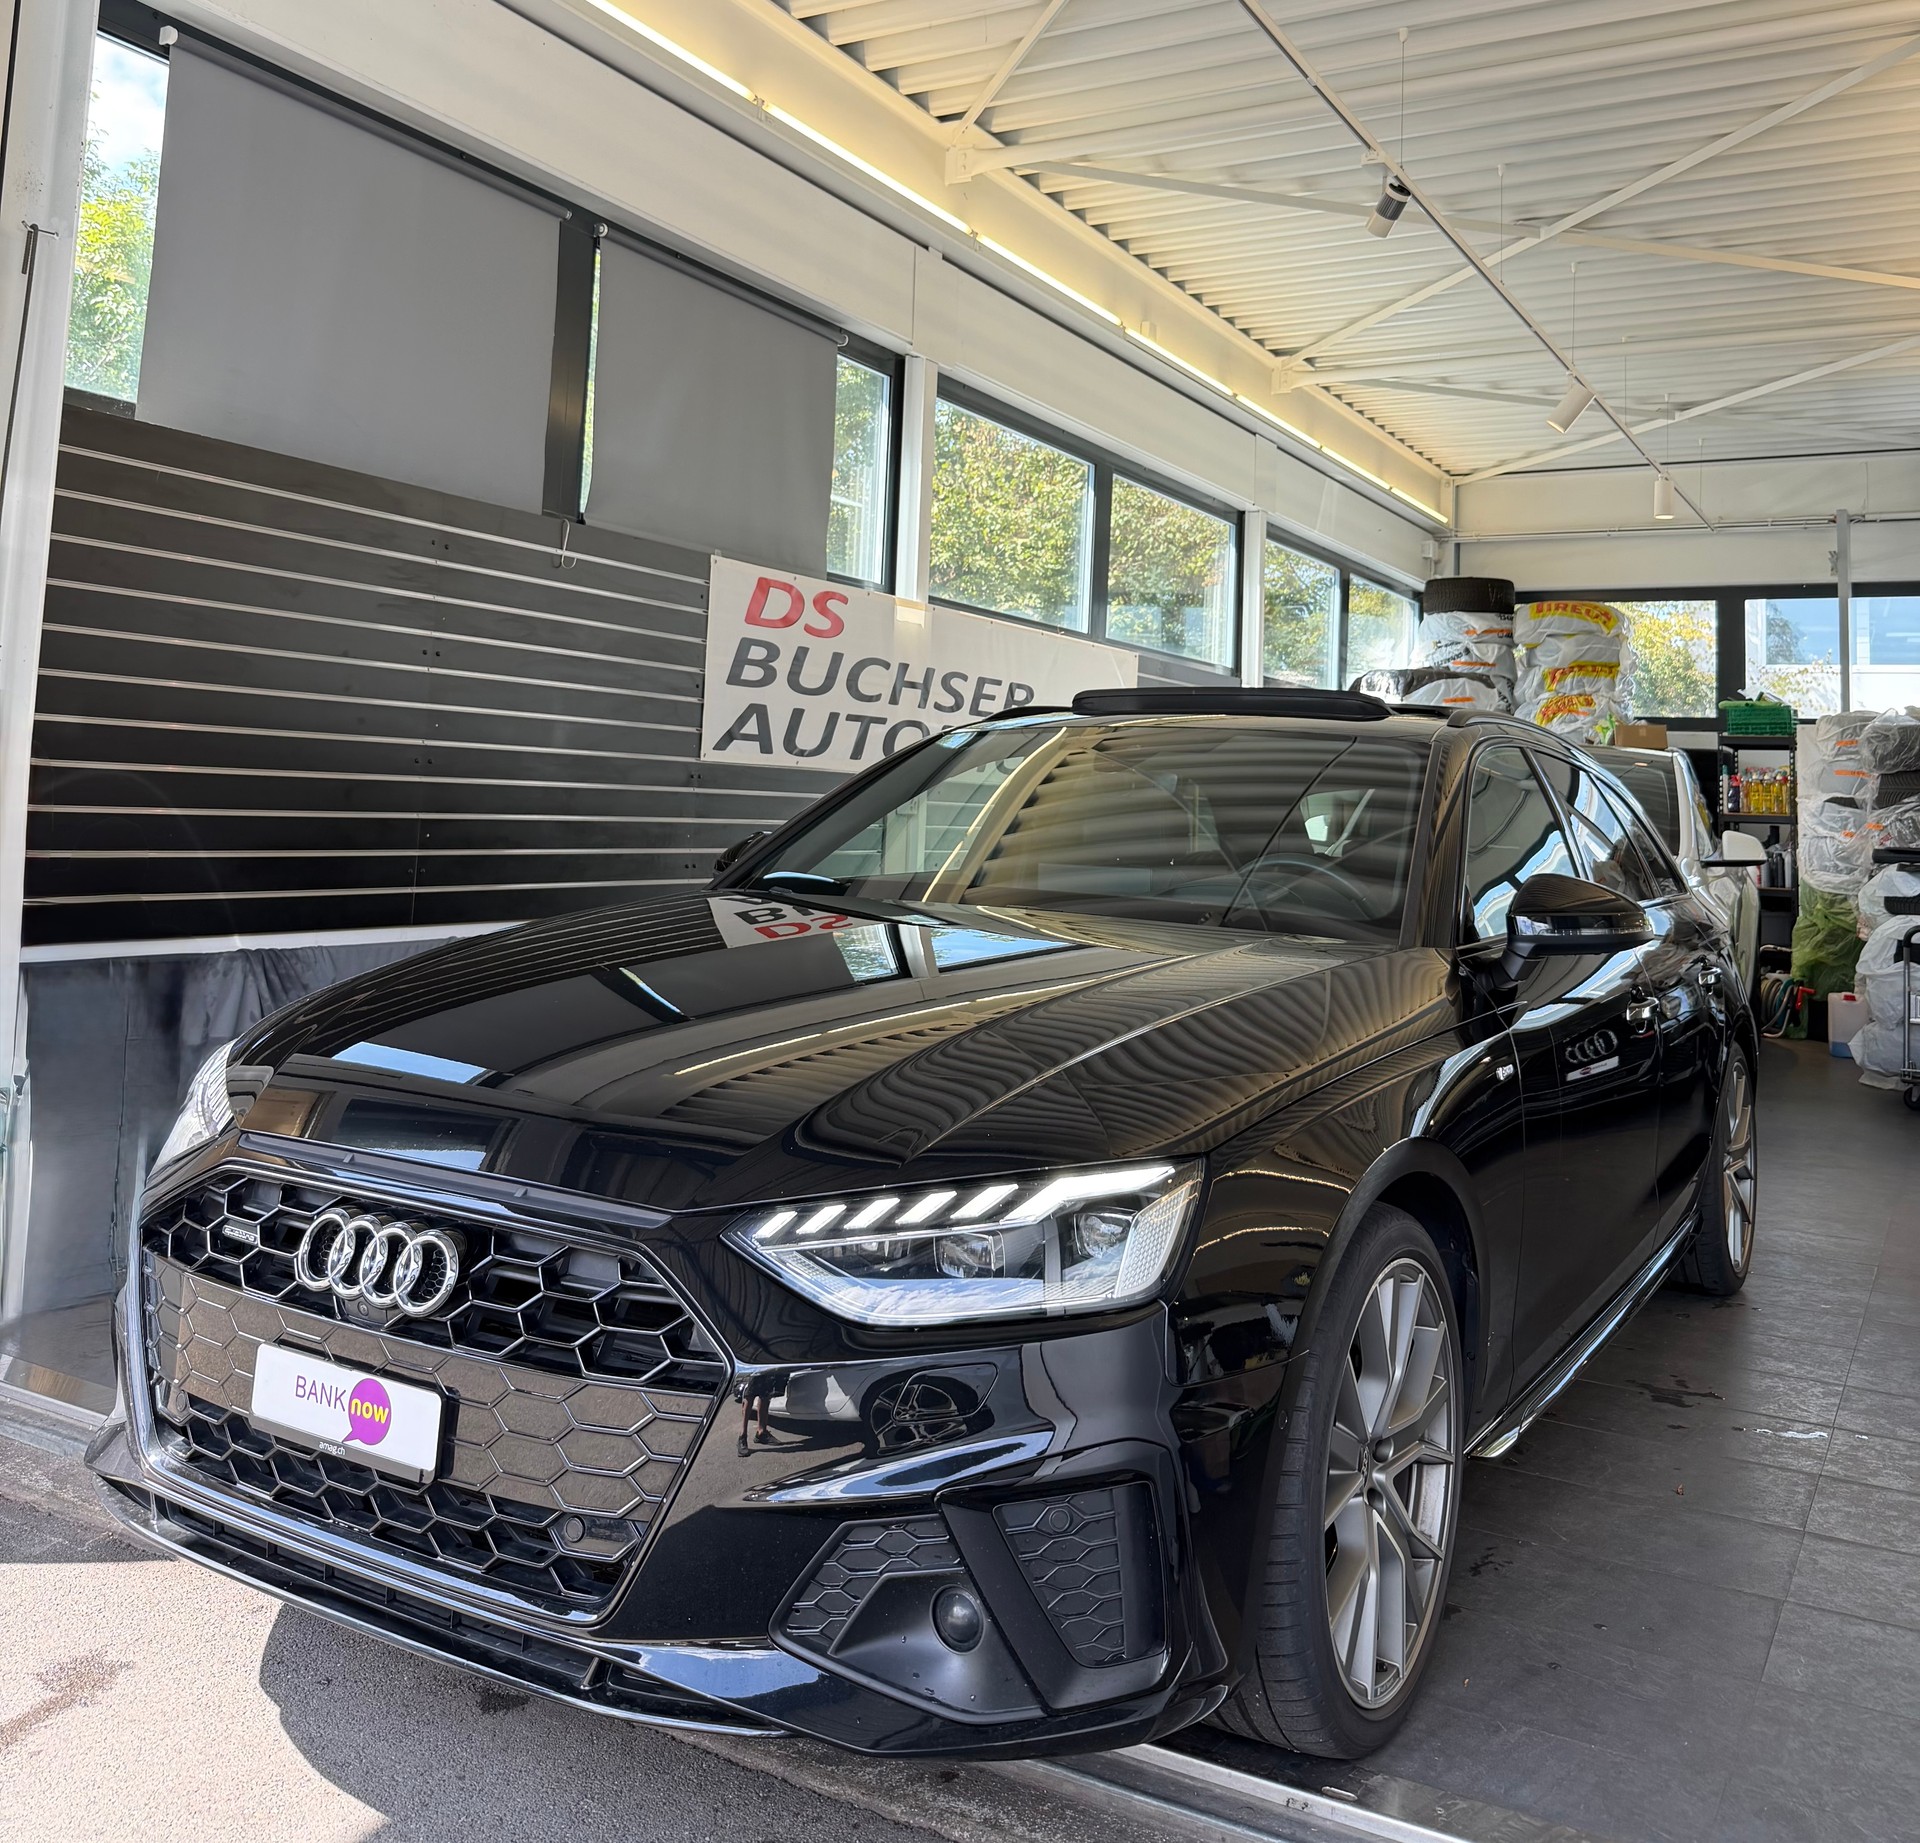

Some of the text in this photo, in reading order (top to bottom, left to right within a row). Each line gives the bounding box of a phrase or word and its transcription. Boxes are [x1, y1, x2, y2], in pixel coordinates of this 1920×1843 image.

[744, 576, 849, 639] DS
[725, 636, 1035, 718] BUCHSER
[712, 702, 956, 760] AUTO
[295, 1374, 389, 1424] BANK now
[318, 1441, 346, 1456] amag.ch
